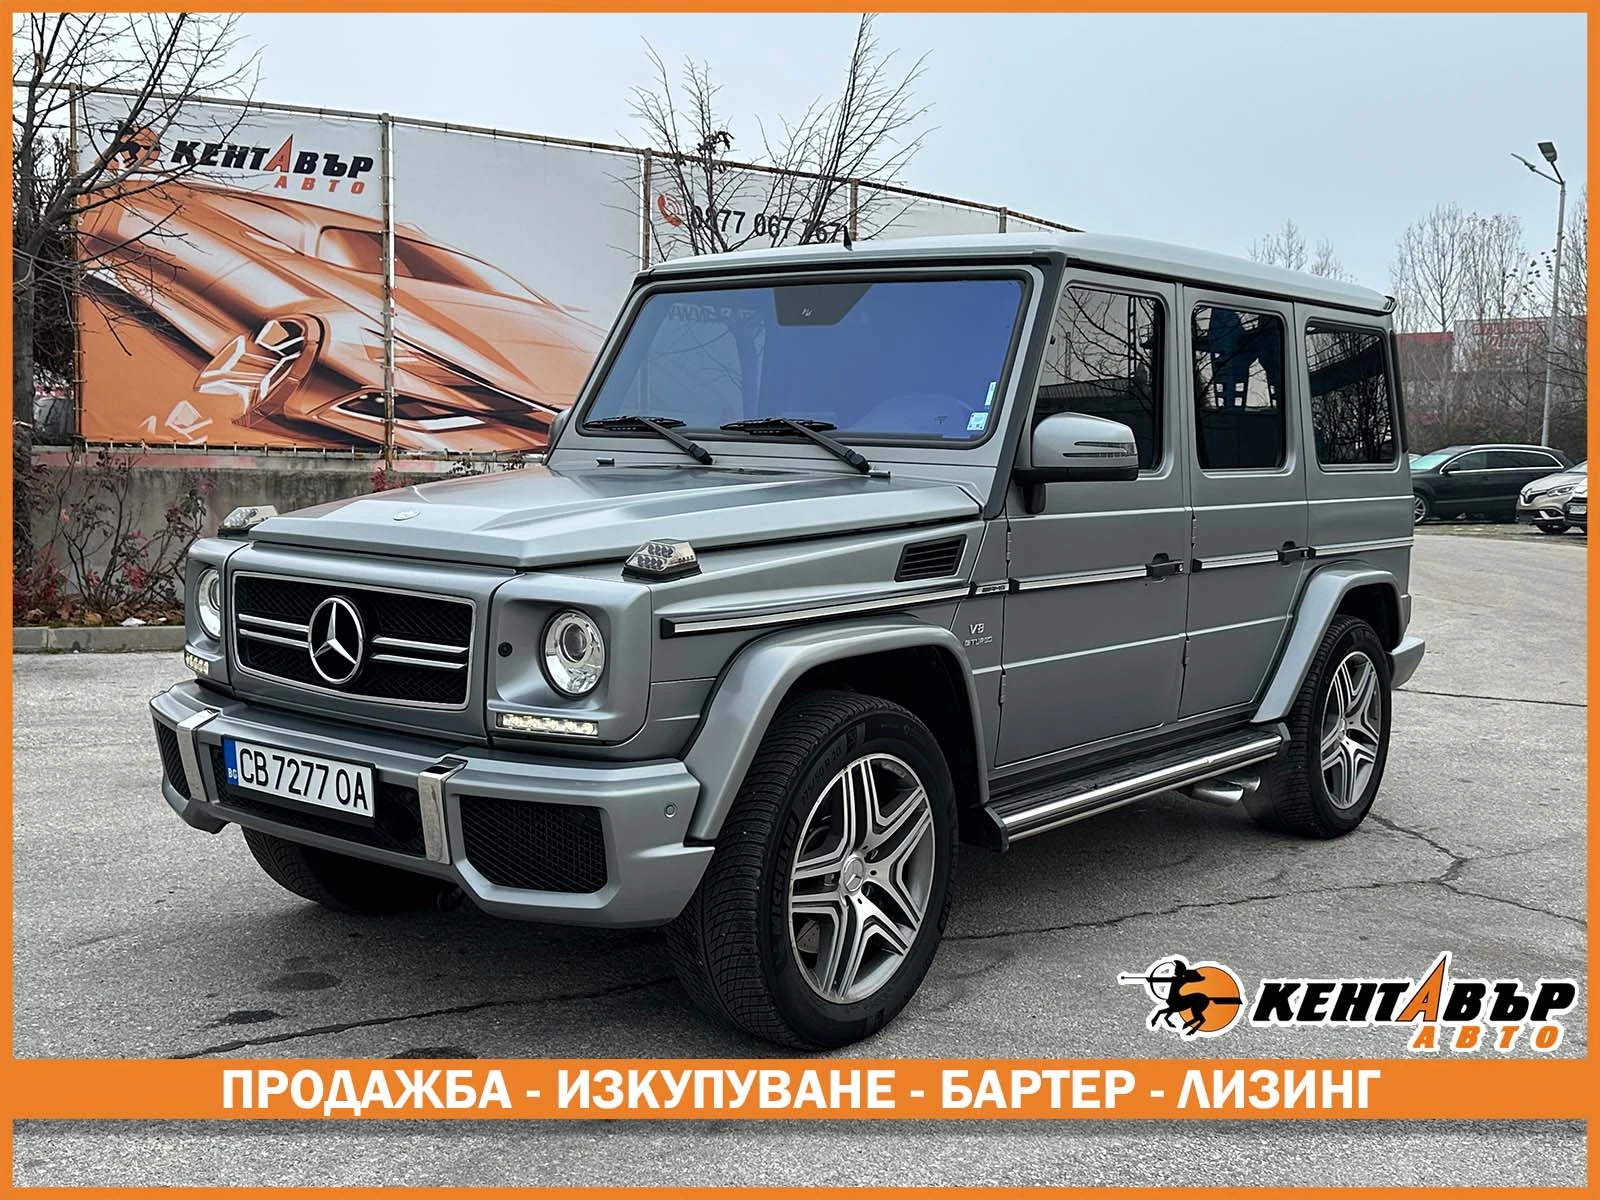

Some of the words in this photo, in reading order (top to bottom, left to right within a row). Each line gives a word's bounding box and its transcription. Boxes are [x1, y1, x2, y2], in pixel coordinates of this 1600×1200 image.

[170, 134, 374, 179] КЕНТАВЪР
[273, 175, 365, 195] АВТО
[754, 213, 795, 239] 067
[802, 219, 841, 243] 67
[969, 623, 985, 634] V8
[227, 767, 239, 780] BG
[239, 748, 269, 787] CB
[272, 754, 330, 801] 7277
